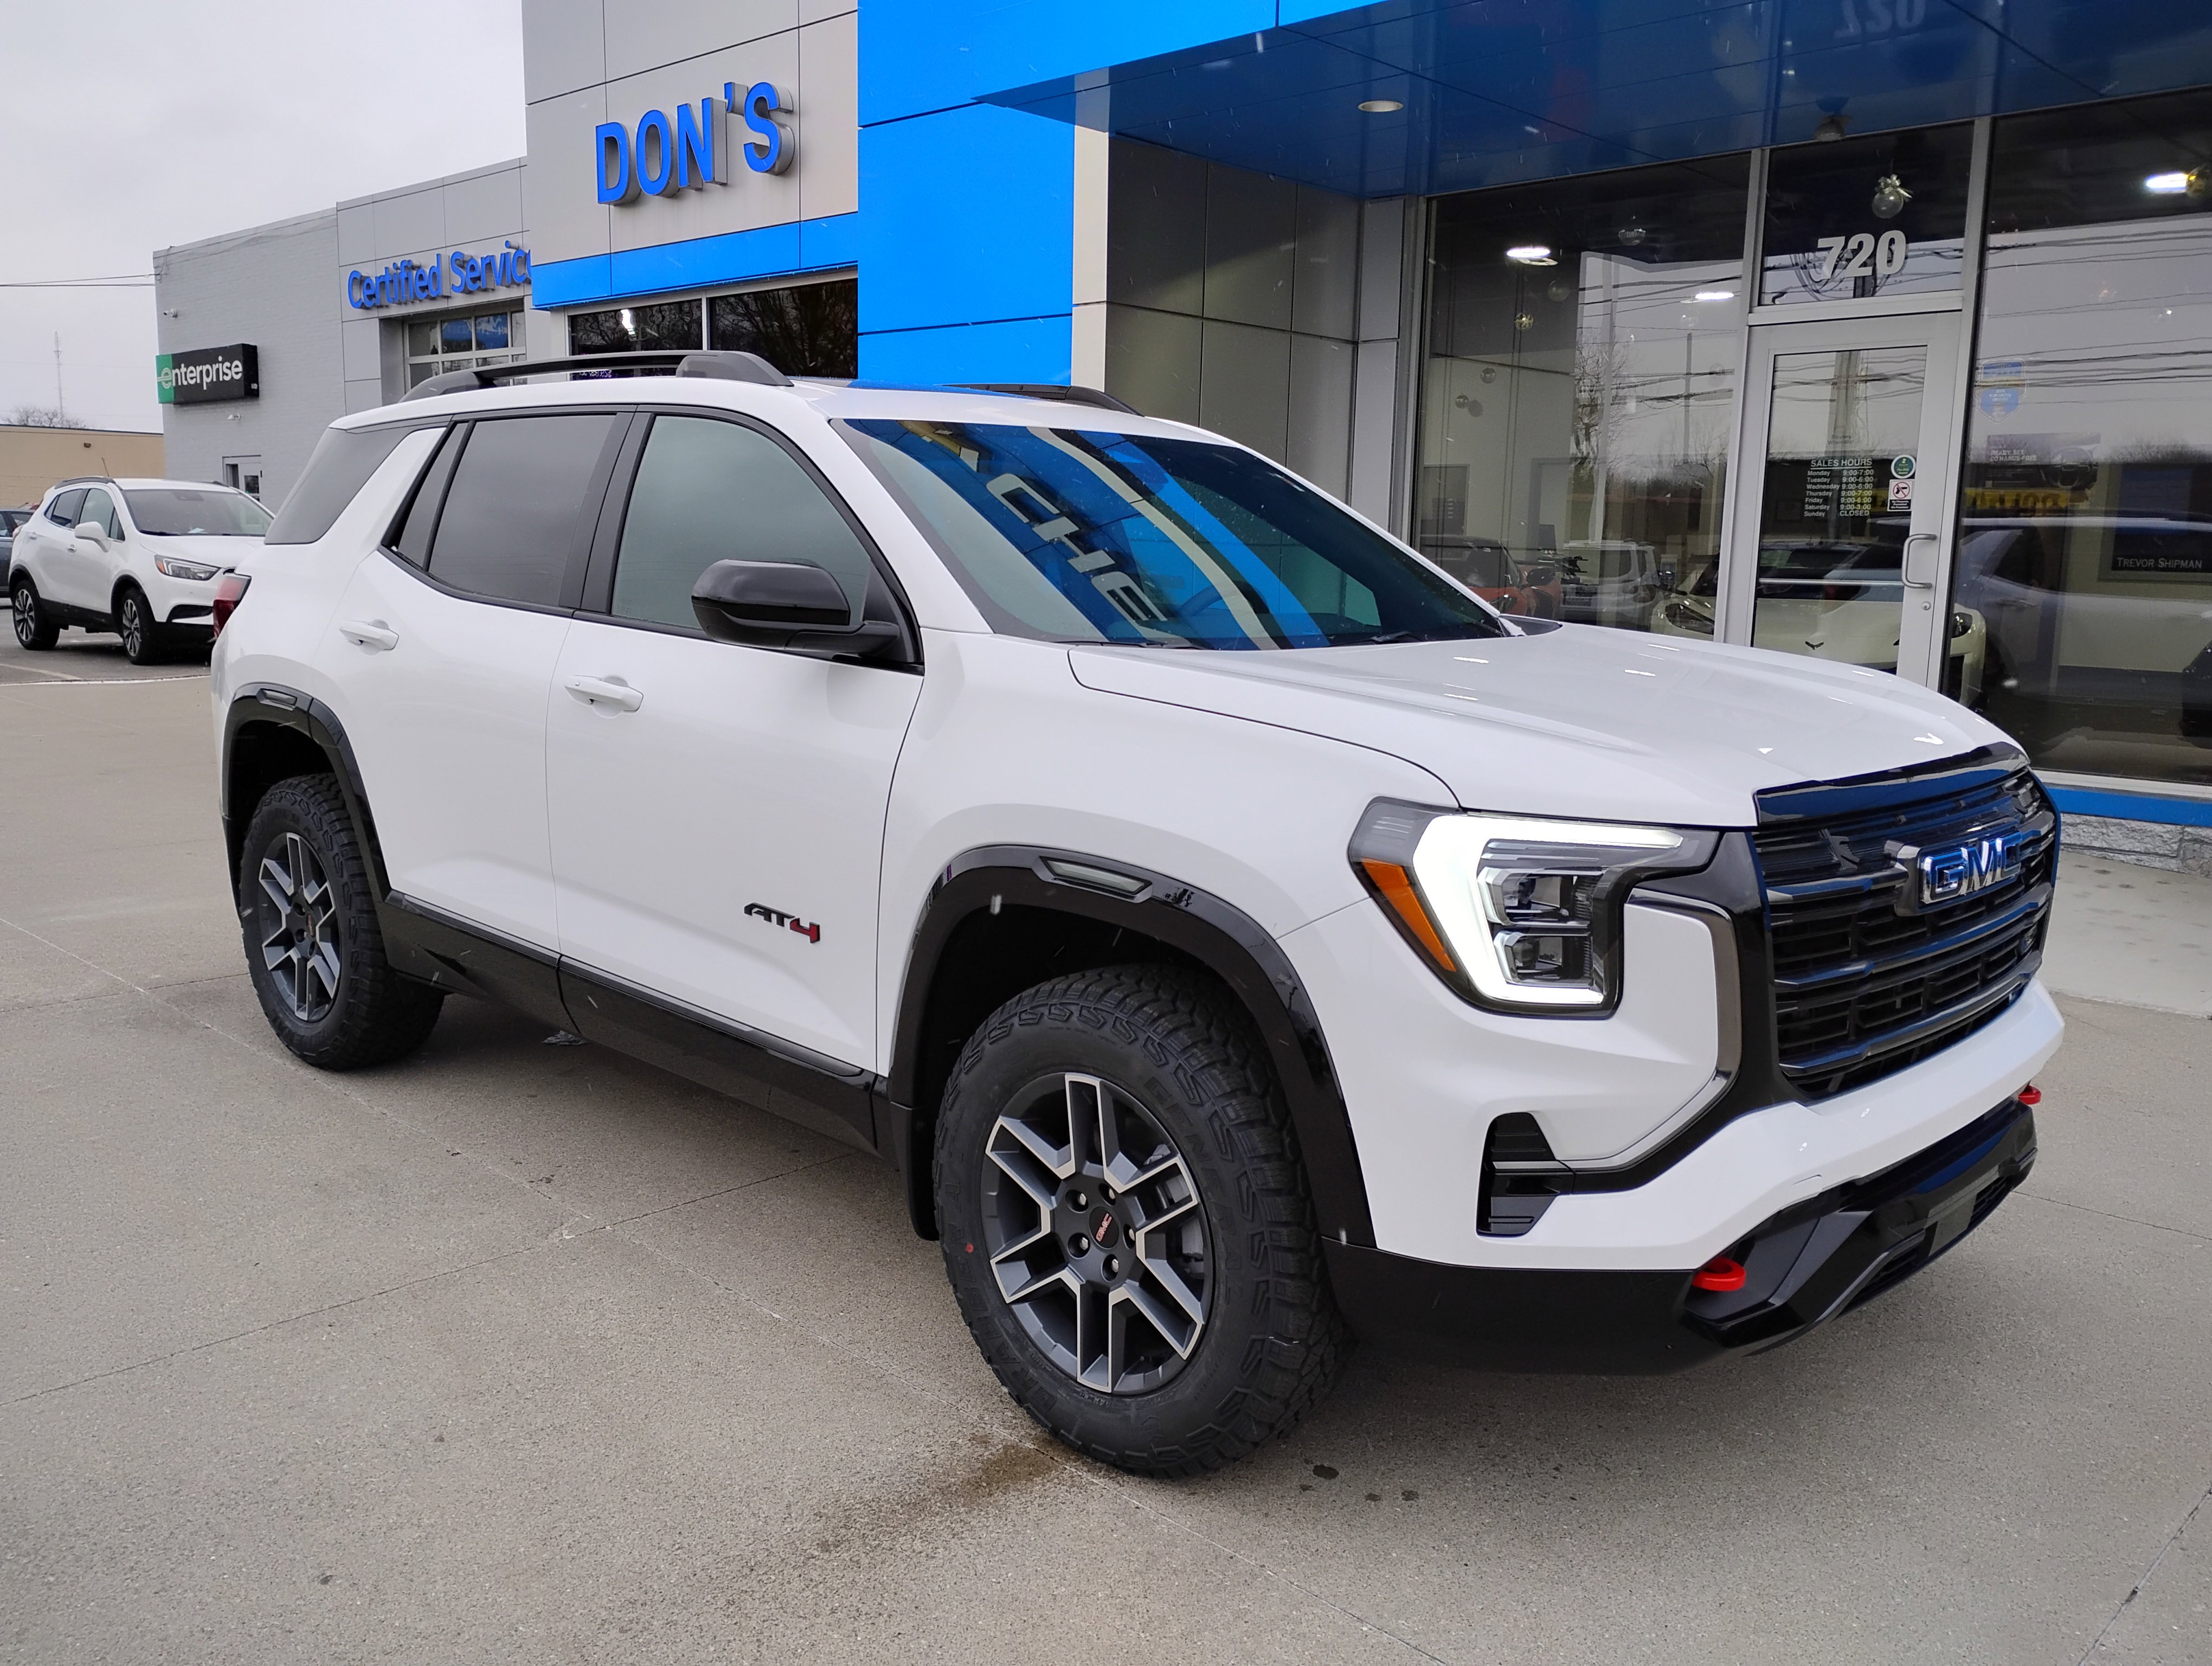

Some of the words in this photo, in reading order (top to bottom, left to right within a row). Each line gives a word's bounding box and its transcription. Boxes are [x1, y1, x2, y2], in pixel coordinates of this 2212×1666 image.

[596, 81, 793, 205] DON'S
[1817, 229, 1907, 280] 720
[348, 253, 445, 310] Certified
[157, 355, 243, 390] enterprise
[1841, 458, 1872, 466] HOURS
[2117, 558, 2155, 567] TREVOR
[2158, 558, 2202, 568] SHIPMAN
[1920, 830, 2023, 905] GMC
[743, 902, 820, 944] AT4
[1144, 1076, 1243, 1305] GENERAL
[1096, 1213, 1113, 1242] GMC
